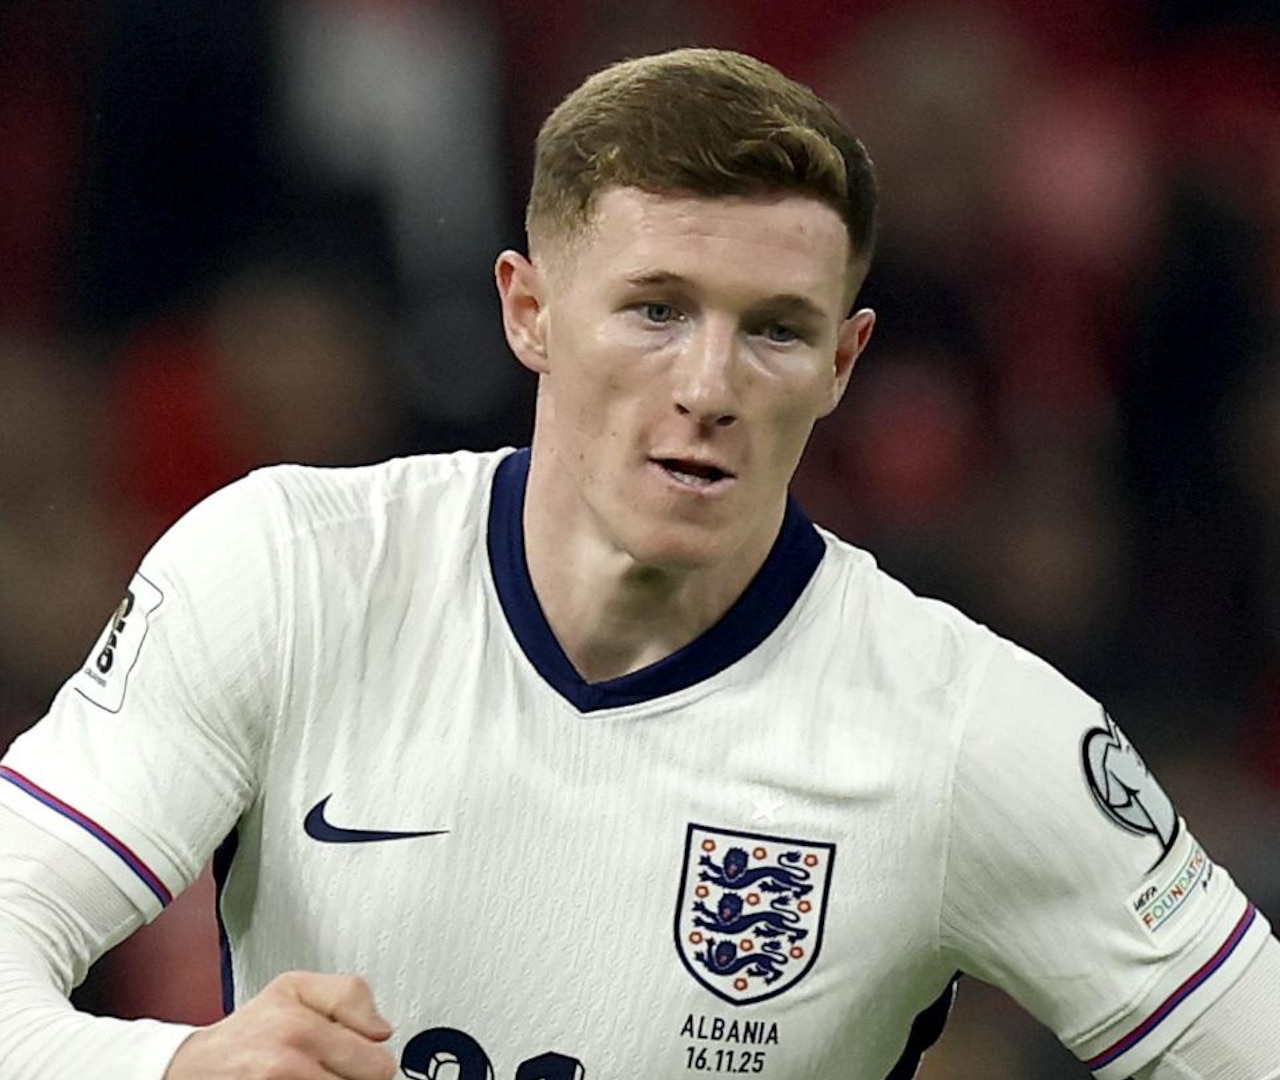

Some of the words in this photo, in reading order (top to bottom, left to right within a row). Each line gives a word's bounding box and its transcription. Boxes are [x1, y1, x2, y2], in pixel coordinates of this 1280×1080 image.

[1142, 848, 1204, 928] FOUNDATIO
[680, 1013, 779, 1045] ALBANIA
[686, 1047, 766, 1073] 16.11.25
